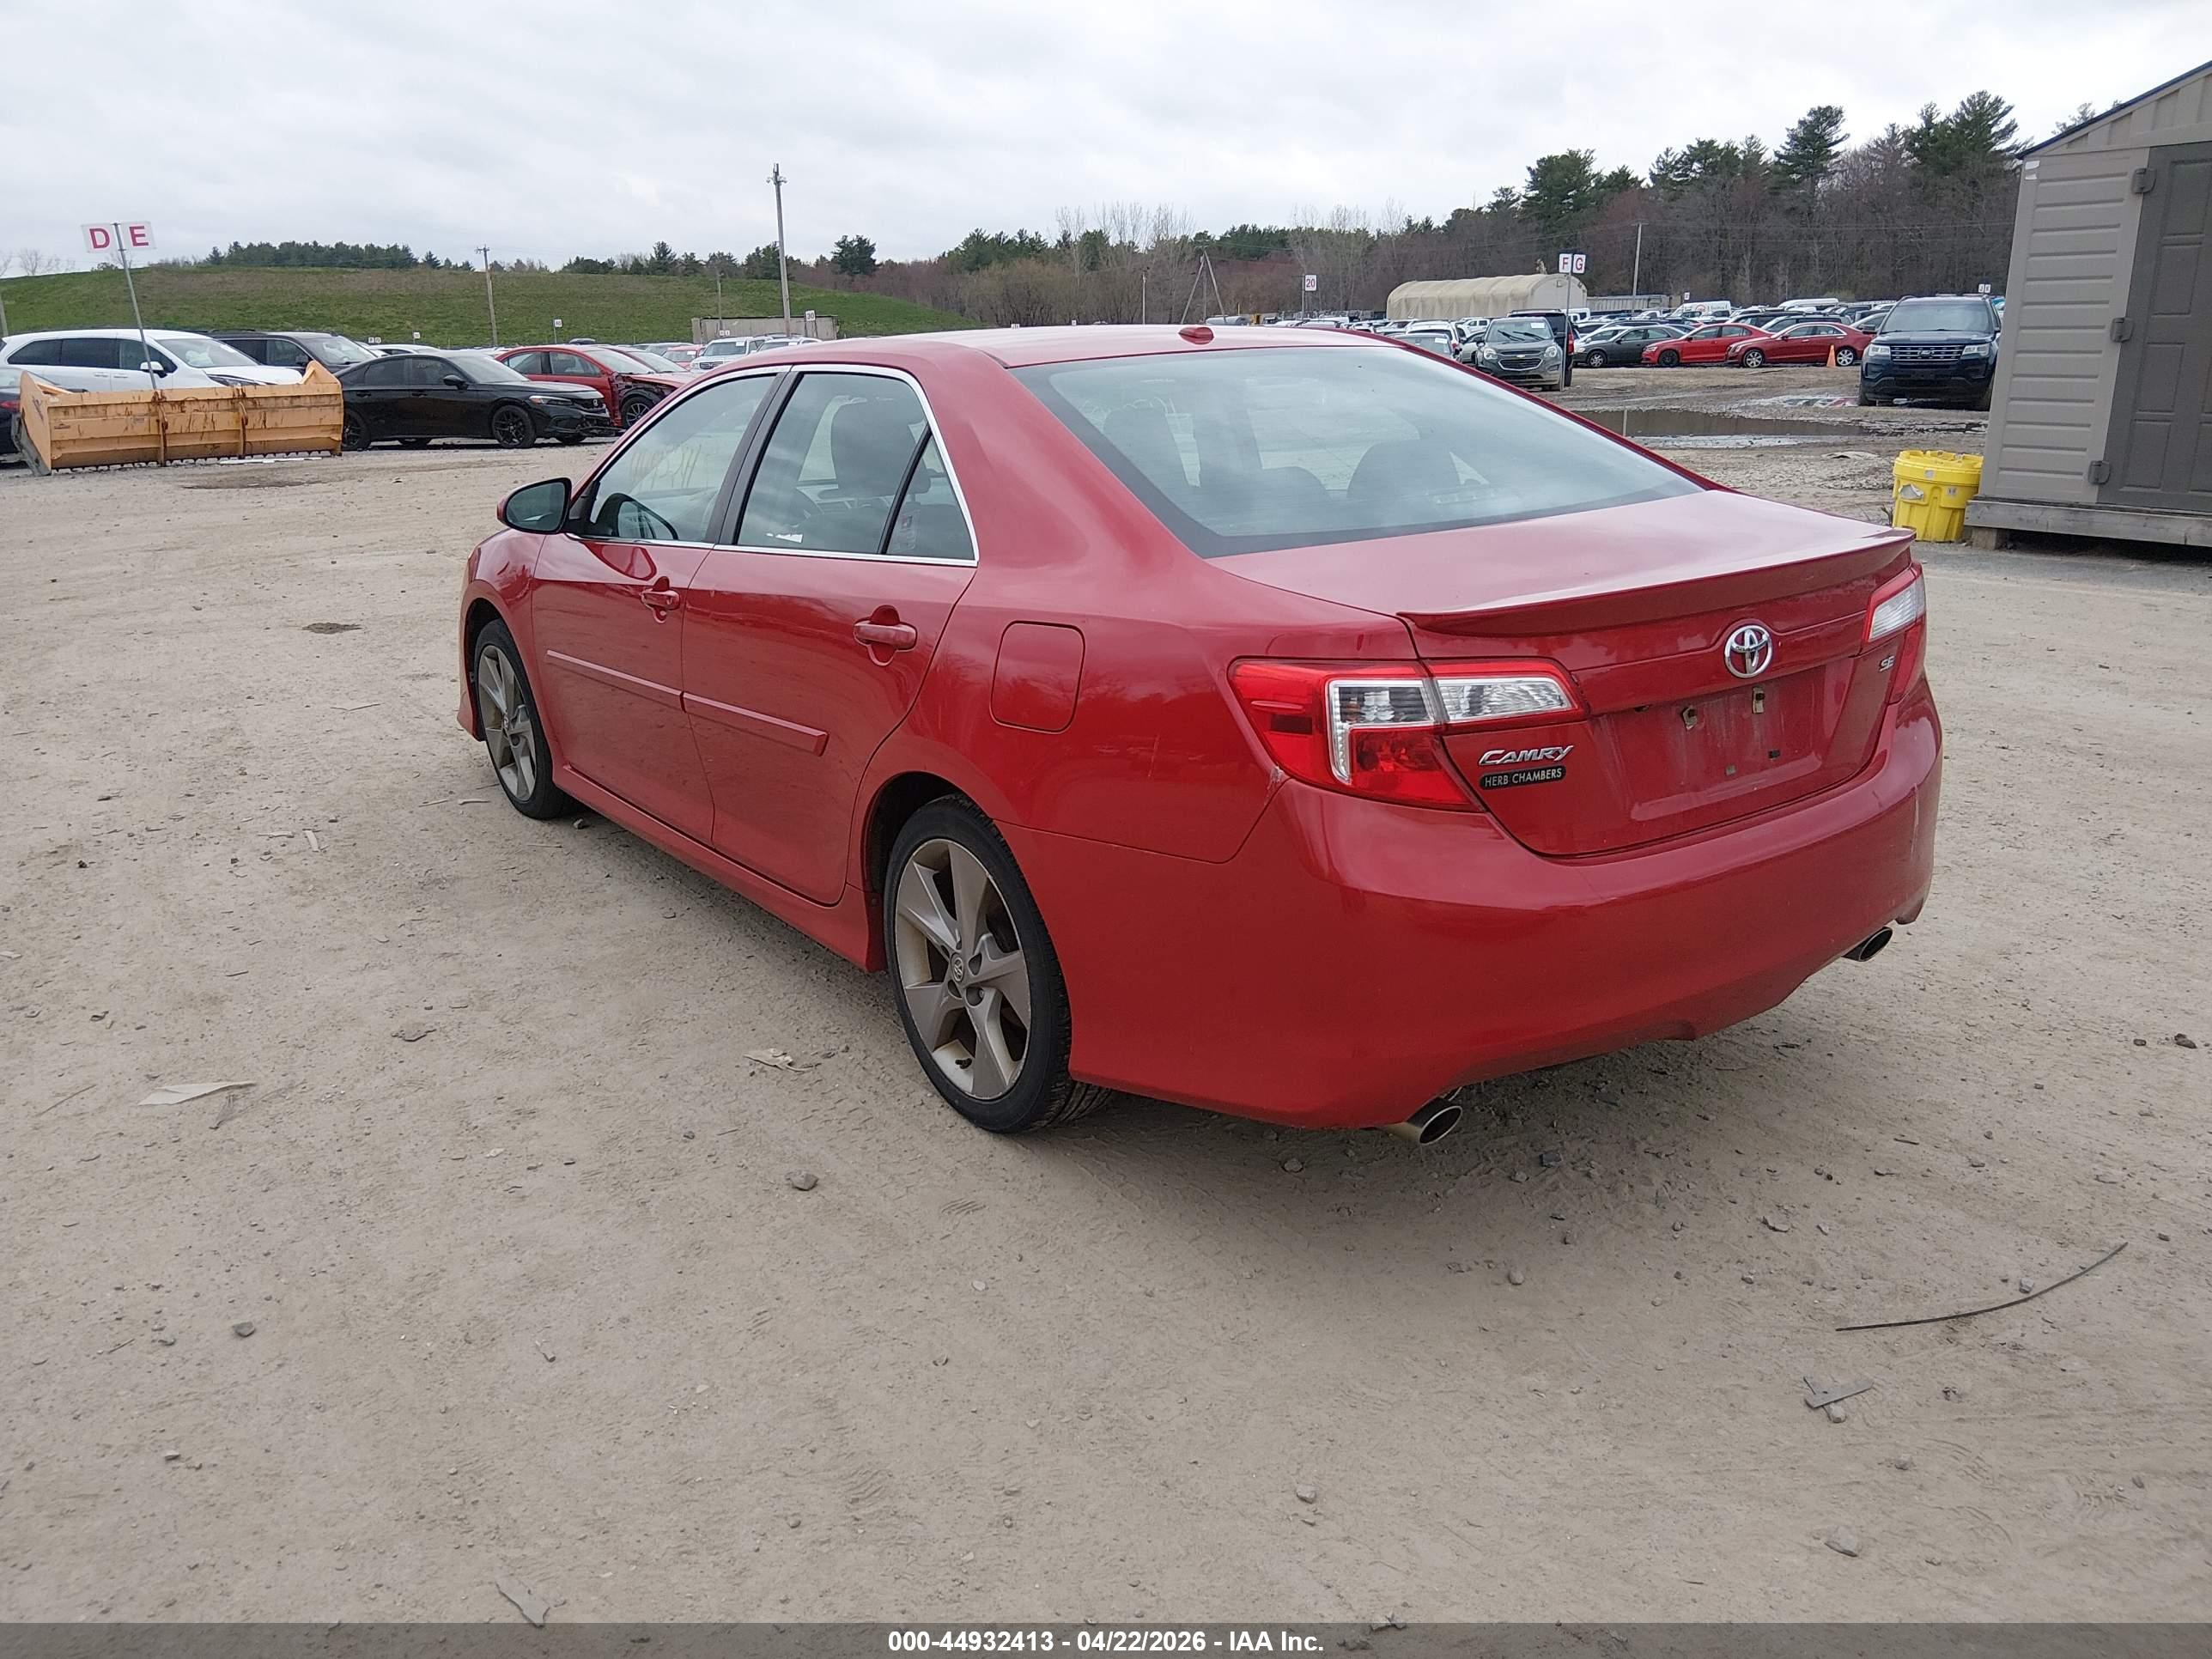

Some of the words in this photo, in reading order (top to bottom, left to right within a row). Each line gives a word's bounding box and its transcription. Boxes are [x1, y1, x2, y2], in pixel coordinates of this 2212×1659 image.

[88, 228, 111, 249] D
[129, 225, 149, 247] E
[1562, 257, 1569, 270] F
[1575, 257, 1584, 271] G
[1305, 278, 1316, 289] 20
[1879, 655, 1895, 672] SE
[1479, 744, 1575, 766] CAMRY
[1485, 775, 1509, 787] HERB
[1511, 768, 1563, 784] CHAMBERS
